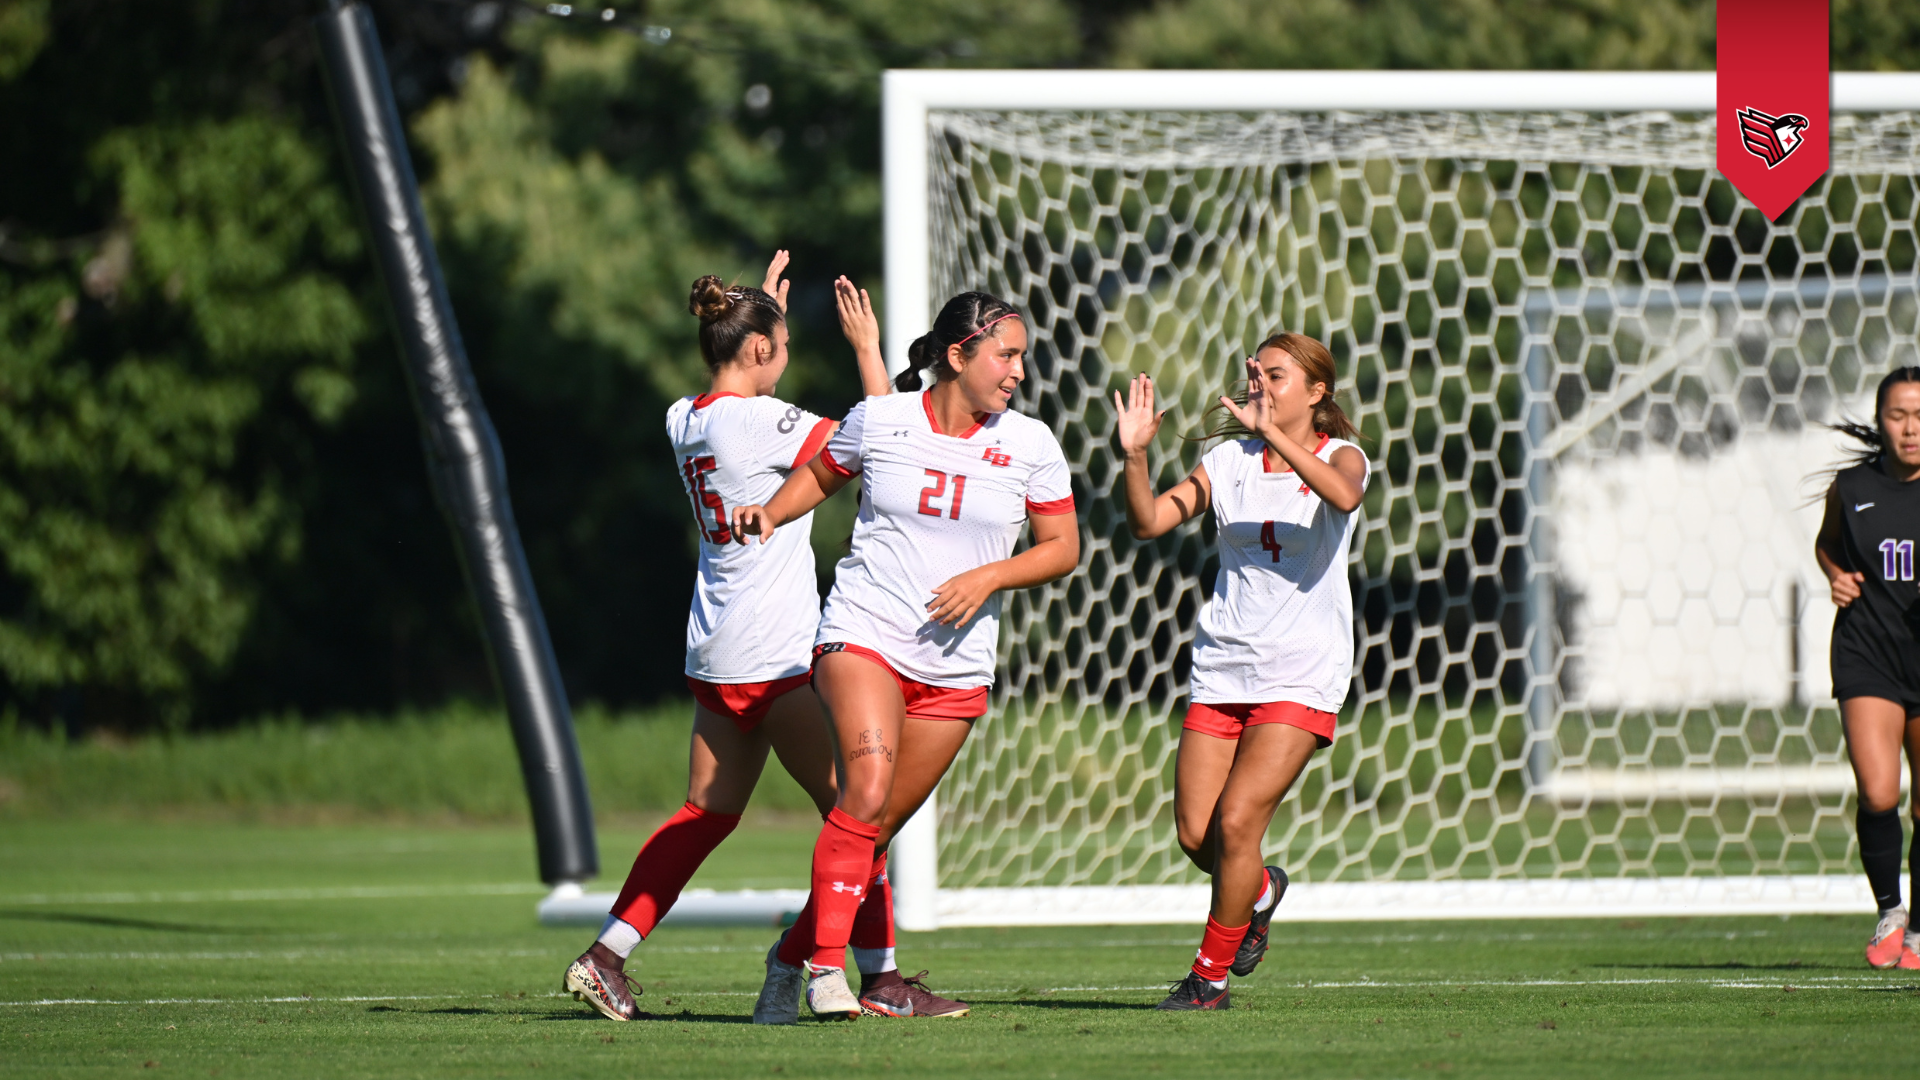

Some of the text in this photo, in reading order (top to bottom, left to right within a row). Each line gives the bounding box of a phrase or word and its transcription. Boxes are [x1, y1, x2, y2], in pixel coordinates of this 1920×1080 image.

[683, 455, 732, 545] 15
[918, 468, 966, 520] 21
[1260, 520, 1283, 563] 4
[1879, 538, 1914, 581] 11
[849, 744, 893, 763] Romans
